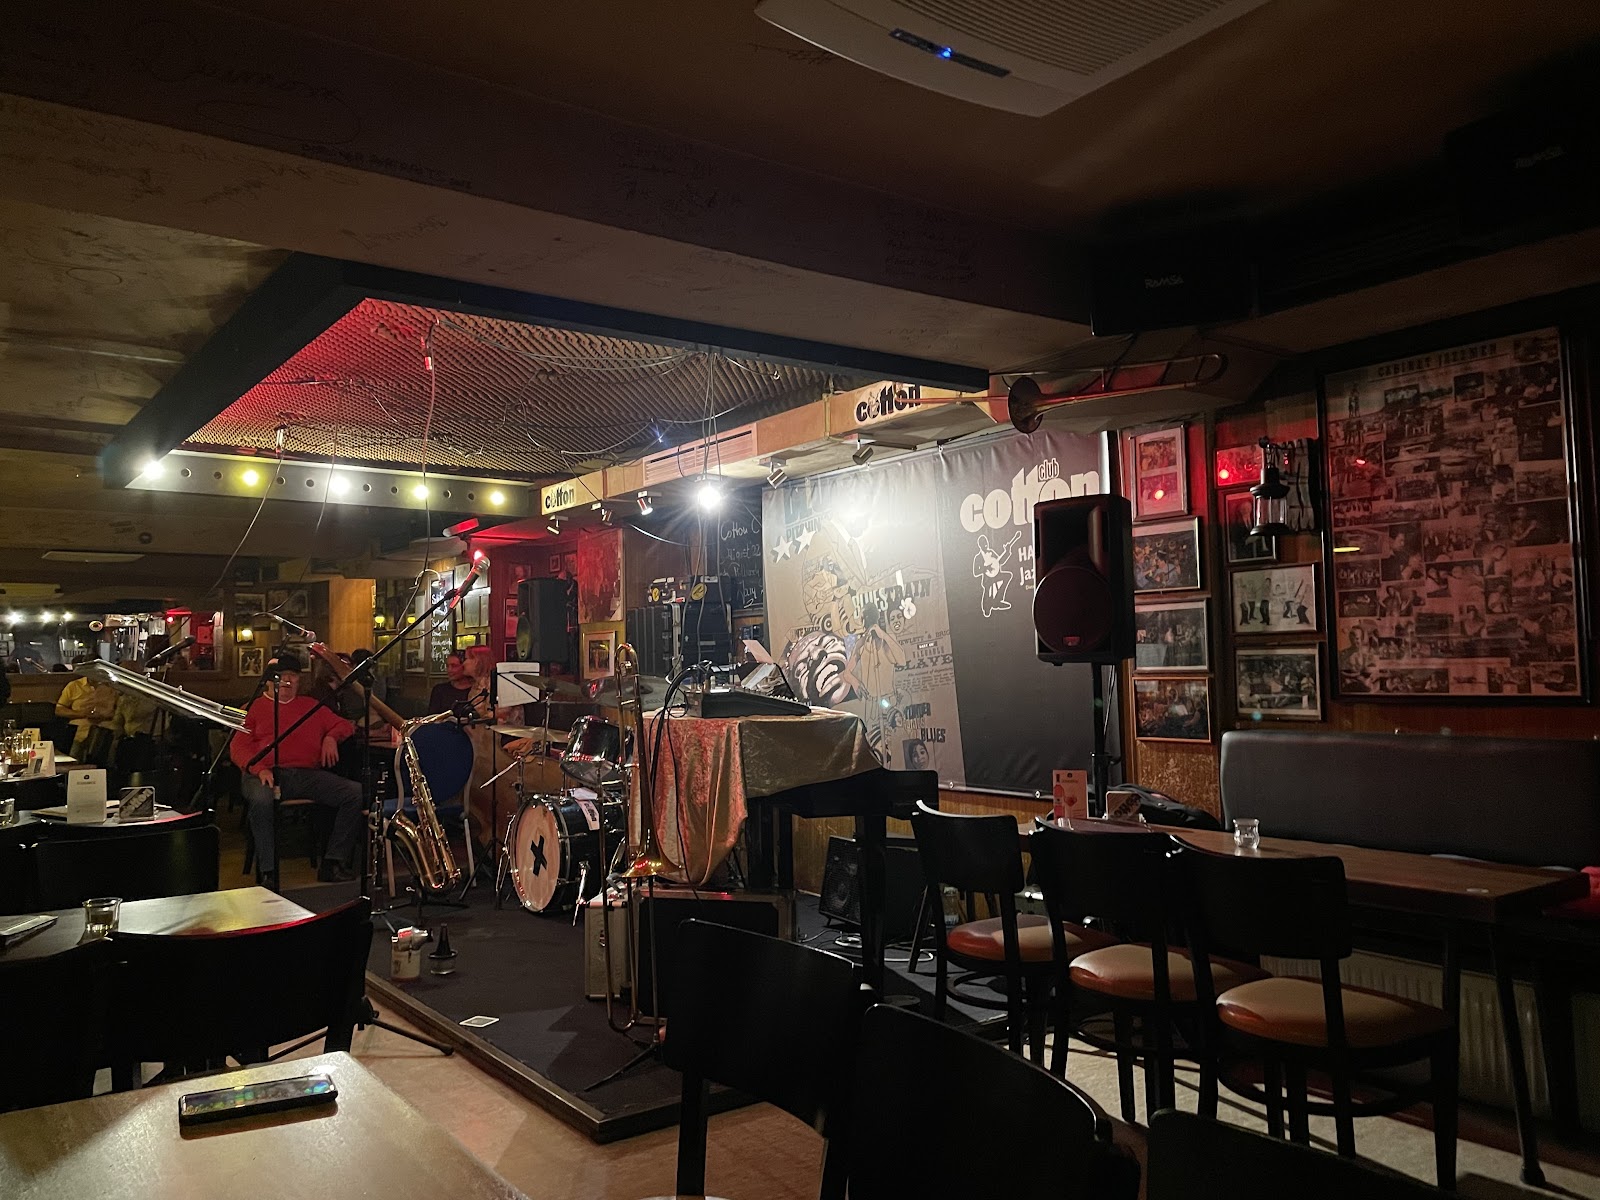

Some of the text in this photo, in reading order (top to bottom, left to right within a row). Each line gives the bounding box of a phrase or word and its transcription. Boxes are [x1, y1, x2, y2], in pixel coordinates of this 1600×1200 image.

[856, 384, 921, 422] cotton
[1038, 458, 1060, 480] club
[545, 487, 575, 509] cotton
[960, 465, 1100, 533] cotton
